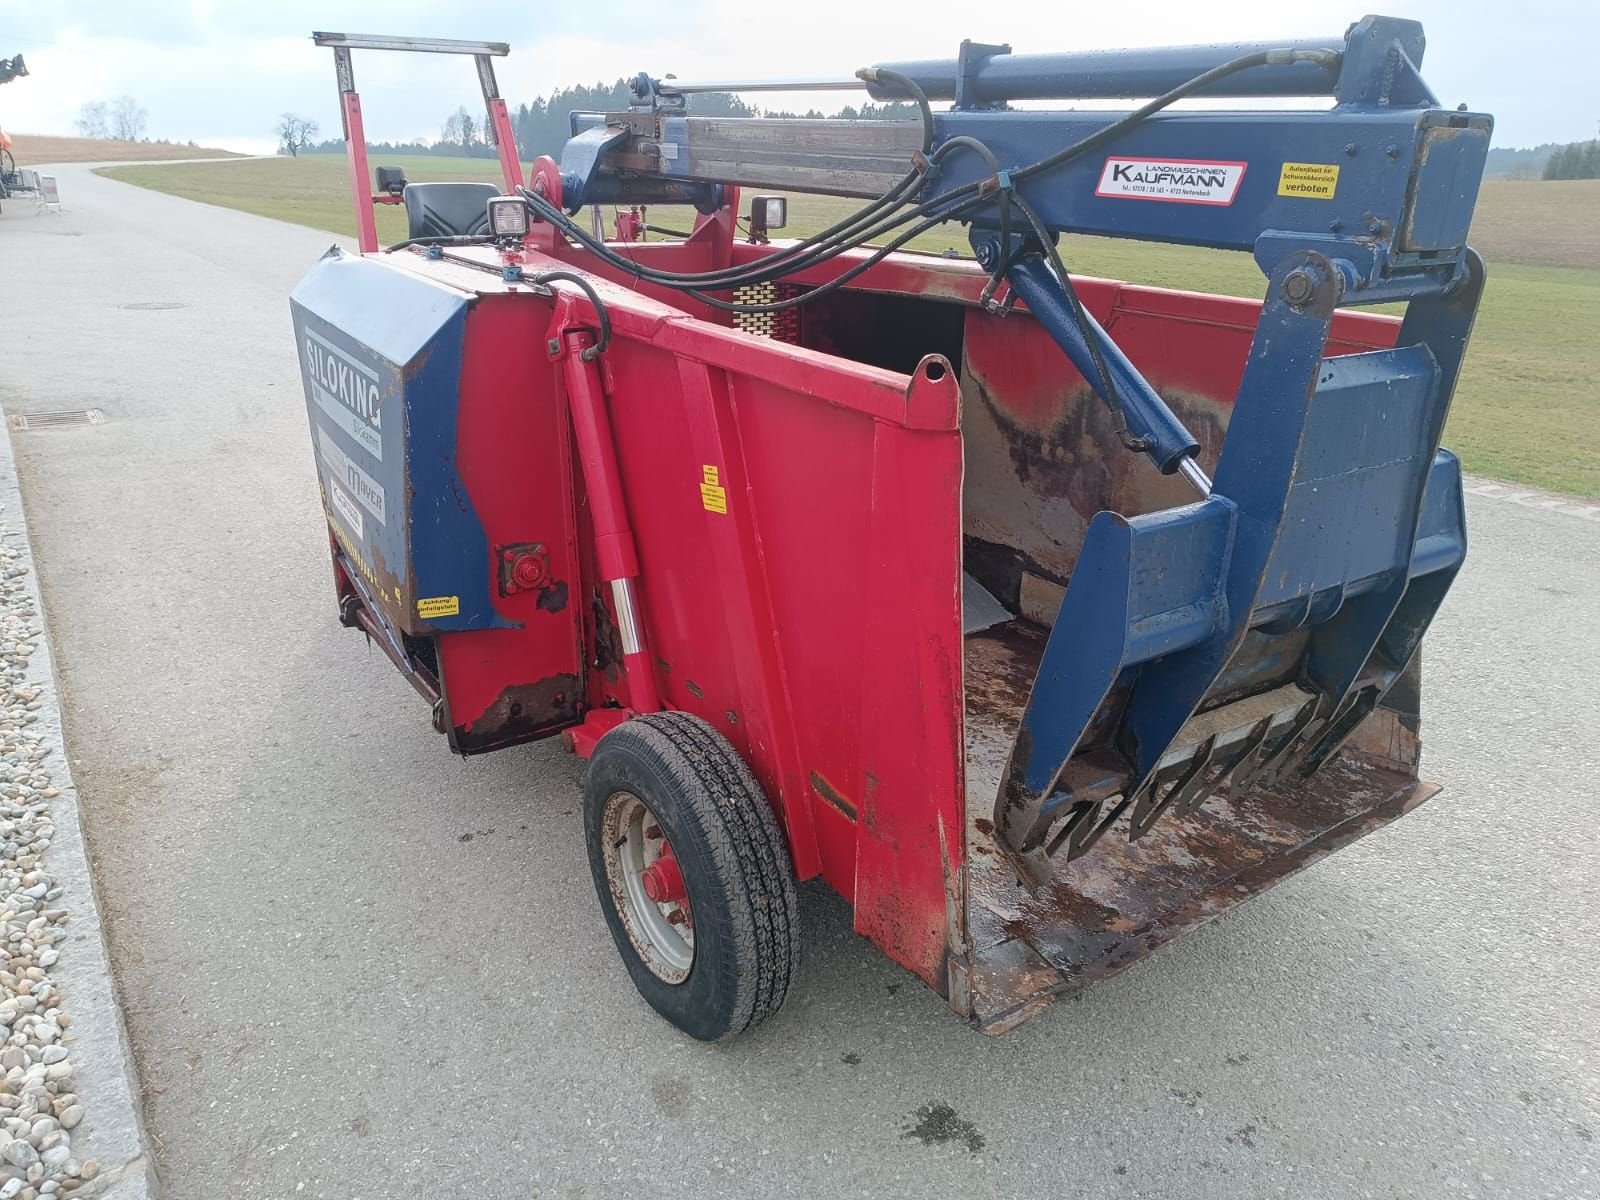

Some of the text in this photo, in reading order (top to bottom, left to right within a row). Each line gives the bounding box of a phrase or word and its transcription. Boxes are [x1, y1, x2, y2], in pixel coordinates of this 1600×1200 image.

[1112, 164, 1226, 188] KAUFMANN
[1145, 165, 1226, 176] LANDMASCHINEN
[1286, 184, 1329, 193] verboten
[306, 339, 381, 430] SILOKING
